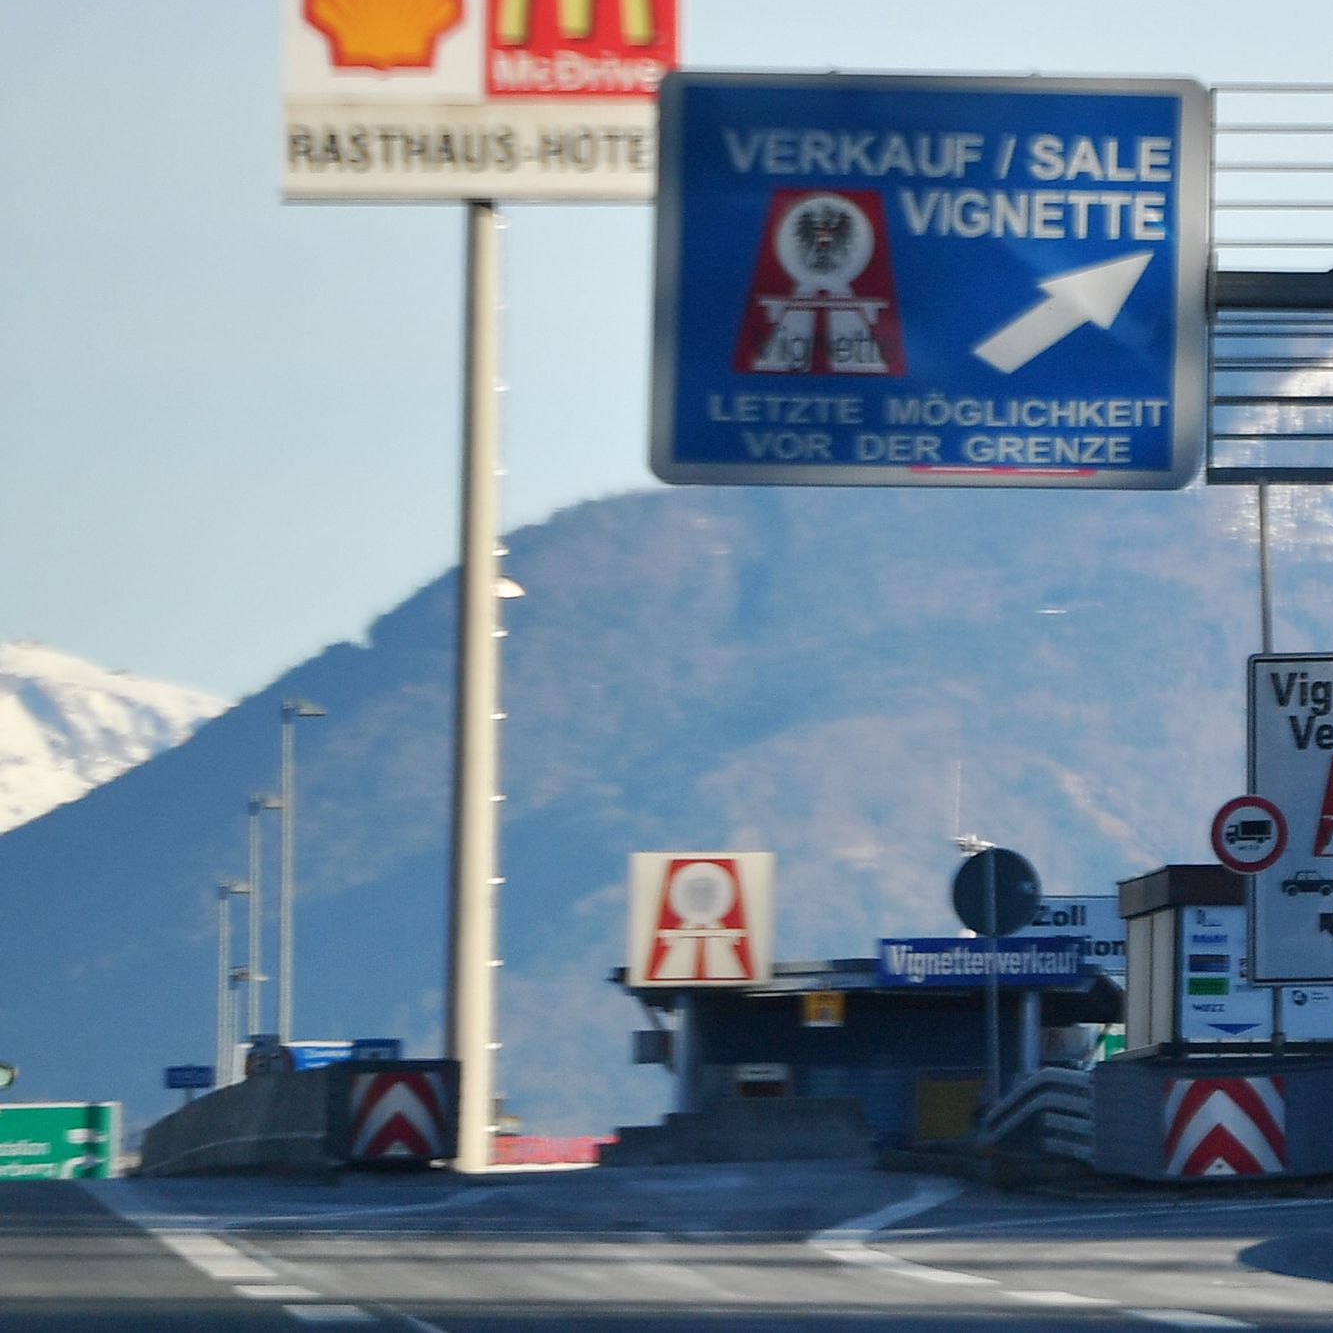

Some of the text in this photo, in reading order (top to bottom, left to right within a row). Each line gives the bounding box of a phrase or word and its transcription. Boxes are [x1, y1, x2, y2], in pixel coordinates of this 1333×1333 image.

[493, 49, 661, 91] McDrive
[288, 123, 653, 172] RASTHAUS-HOTE
[725, 130, 1170, 182] VERKAUF / SALE
[901, 190, 1166, 241] VIGNETTE
[708, 393, 1168, 429] LETZTE MÖGLICHKEIT
[744, 431, 1131, 465] VOR DER GRENZE
[1032, 905, 1087, 926] Zoll
